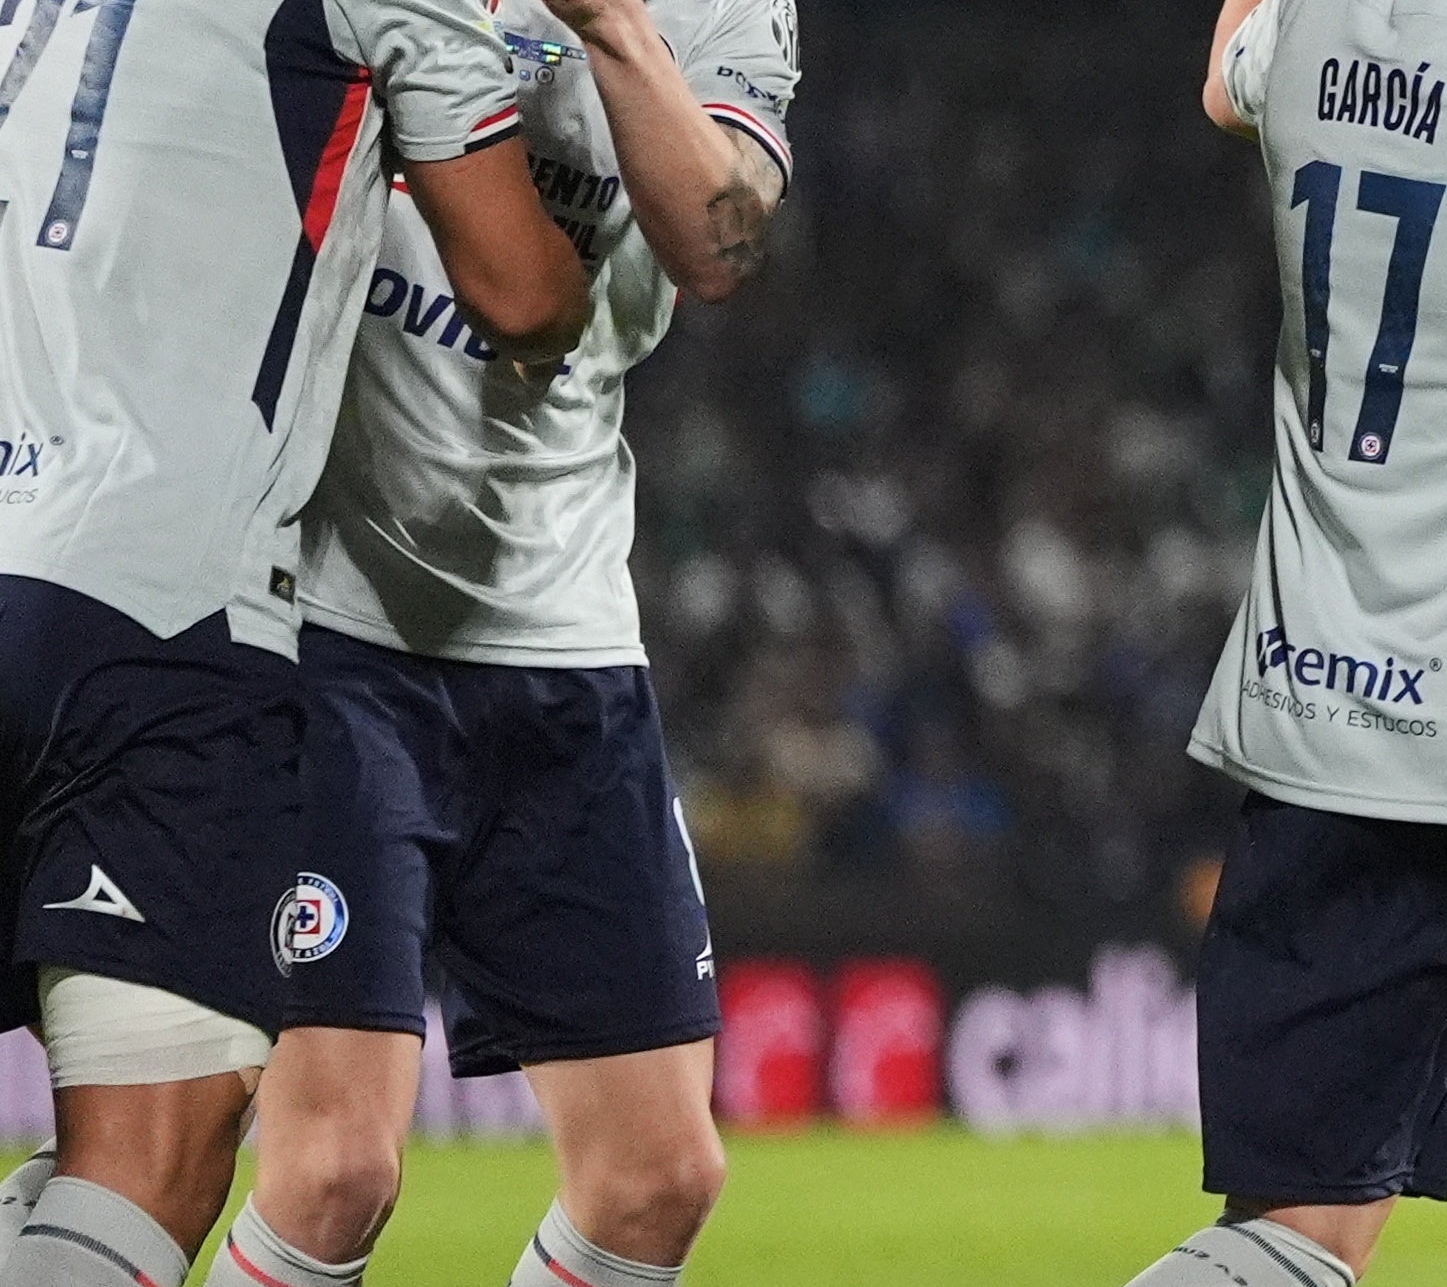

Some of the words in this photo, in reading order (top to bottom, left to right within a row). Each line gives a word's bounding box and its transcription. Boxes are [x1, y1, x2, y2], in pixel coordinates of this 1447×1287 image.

[1317, 58, 1446, 145] GARCÍA
[1290, 159, 1447, 465] 17
[1287, 643, 1425, 705] emix
[1326, 705, 1340, 722] Y
[1347, 710, 1438, 738] ESTUCOS
